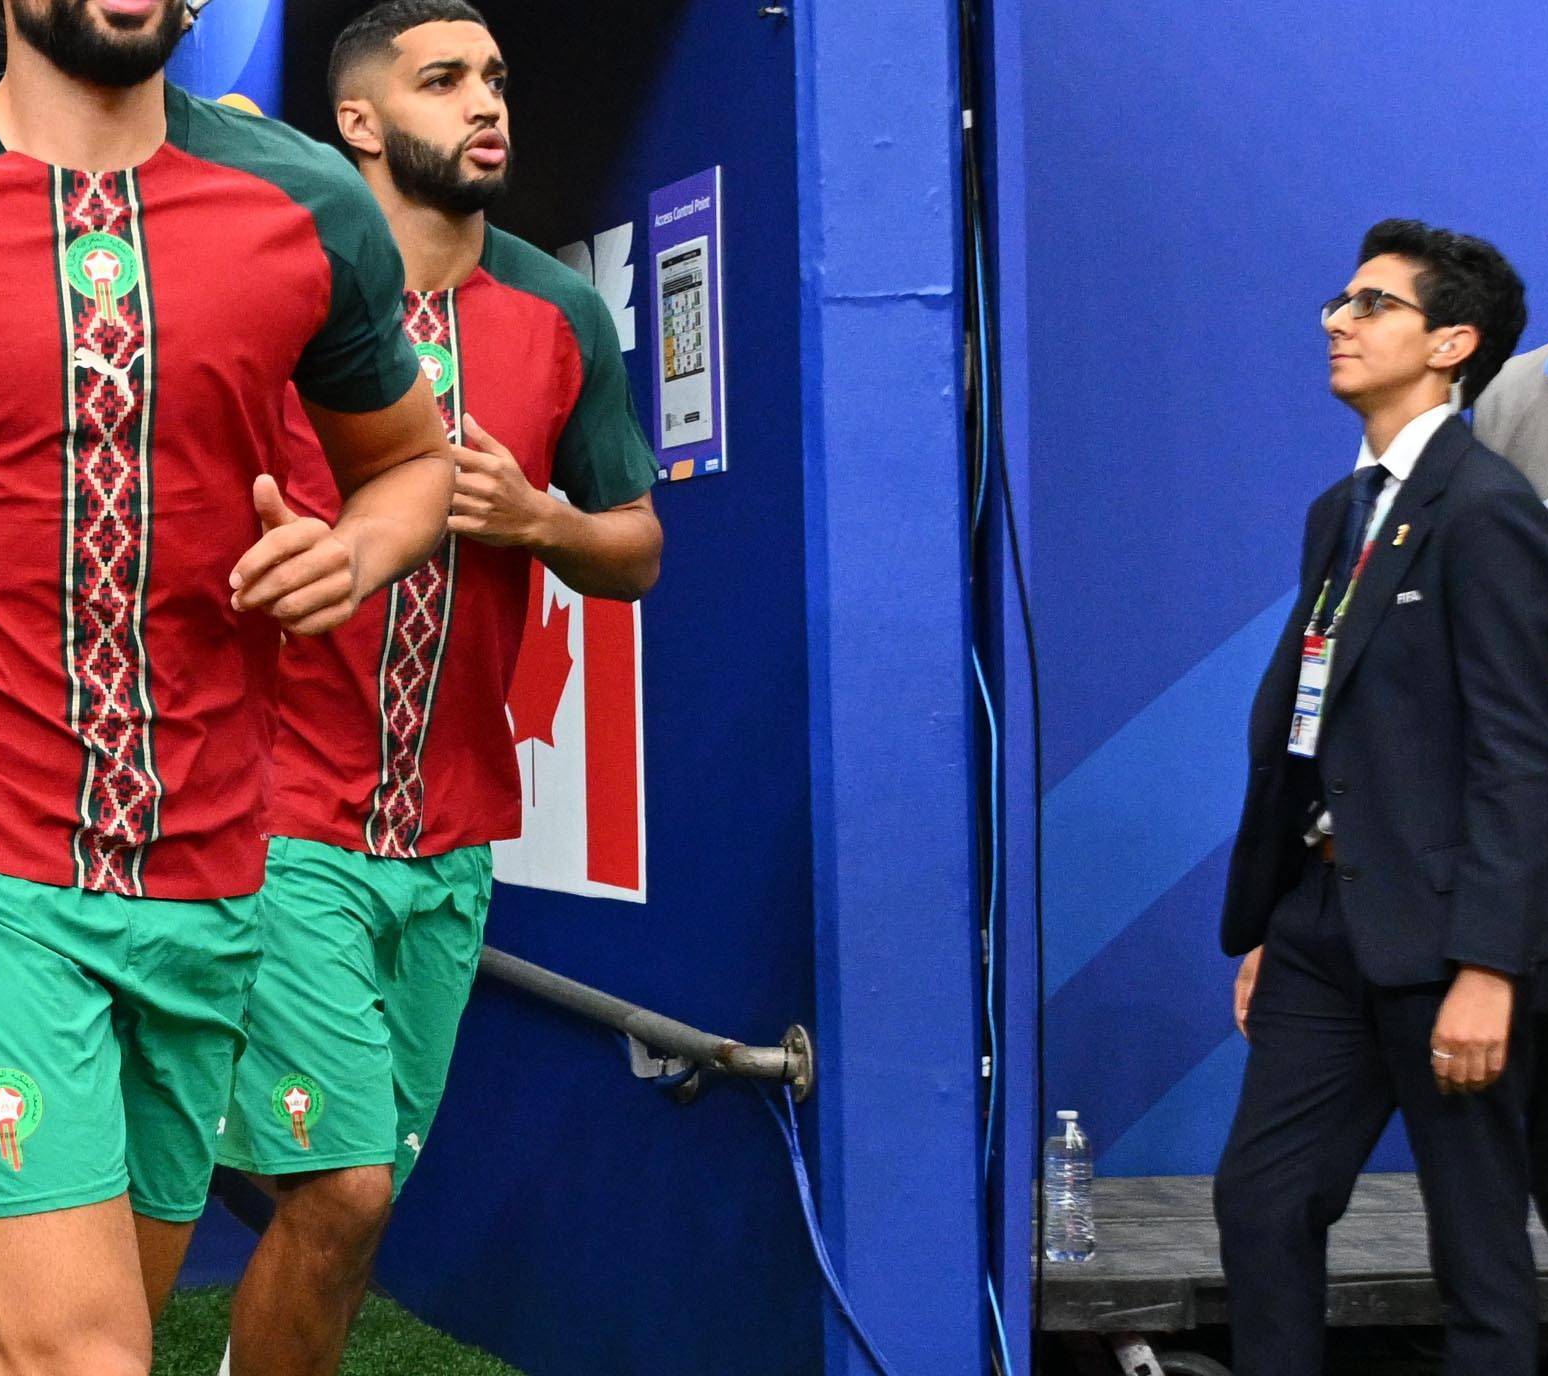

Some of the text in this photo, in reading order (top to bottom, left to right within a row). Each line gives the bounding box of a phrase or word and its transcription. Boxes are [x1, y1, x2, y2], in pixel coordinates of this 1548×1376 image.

[654, 195, 711, 227] Access Control Point
